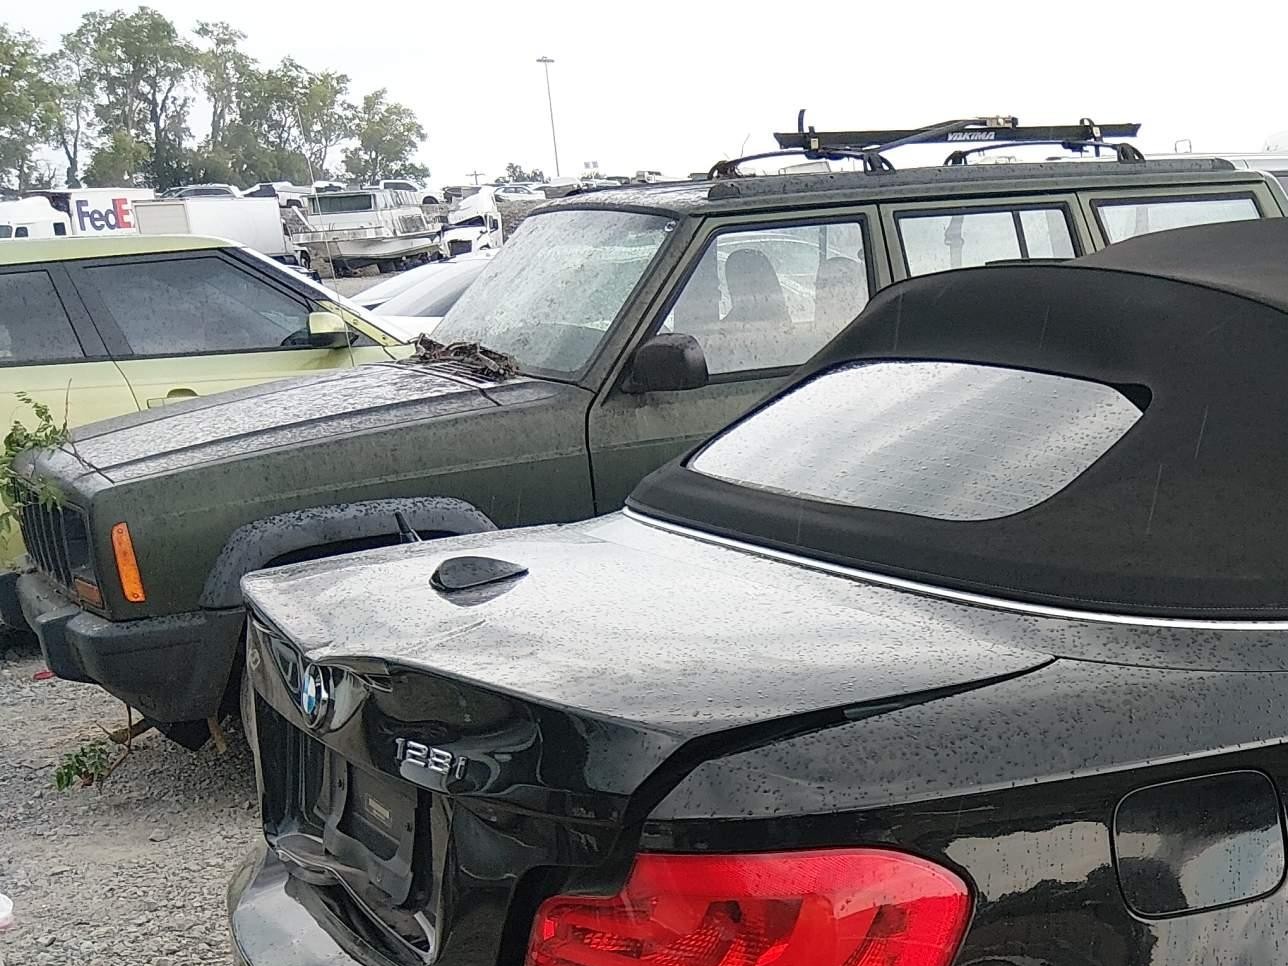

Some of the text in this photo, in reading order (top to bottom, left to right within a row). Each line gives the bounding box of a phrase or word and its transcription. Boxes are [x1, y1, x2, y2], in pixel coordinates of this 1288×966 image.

[947, 131, 996, 141] YAKIMA
[76, 197, 135, 231] FedE
[395, 737, 468, 780] 128i
